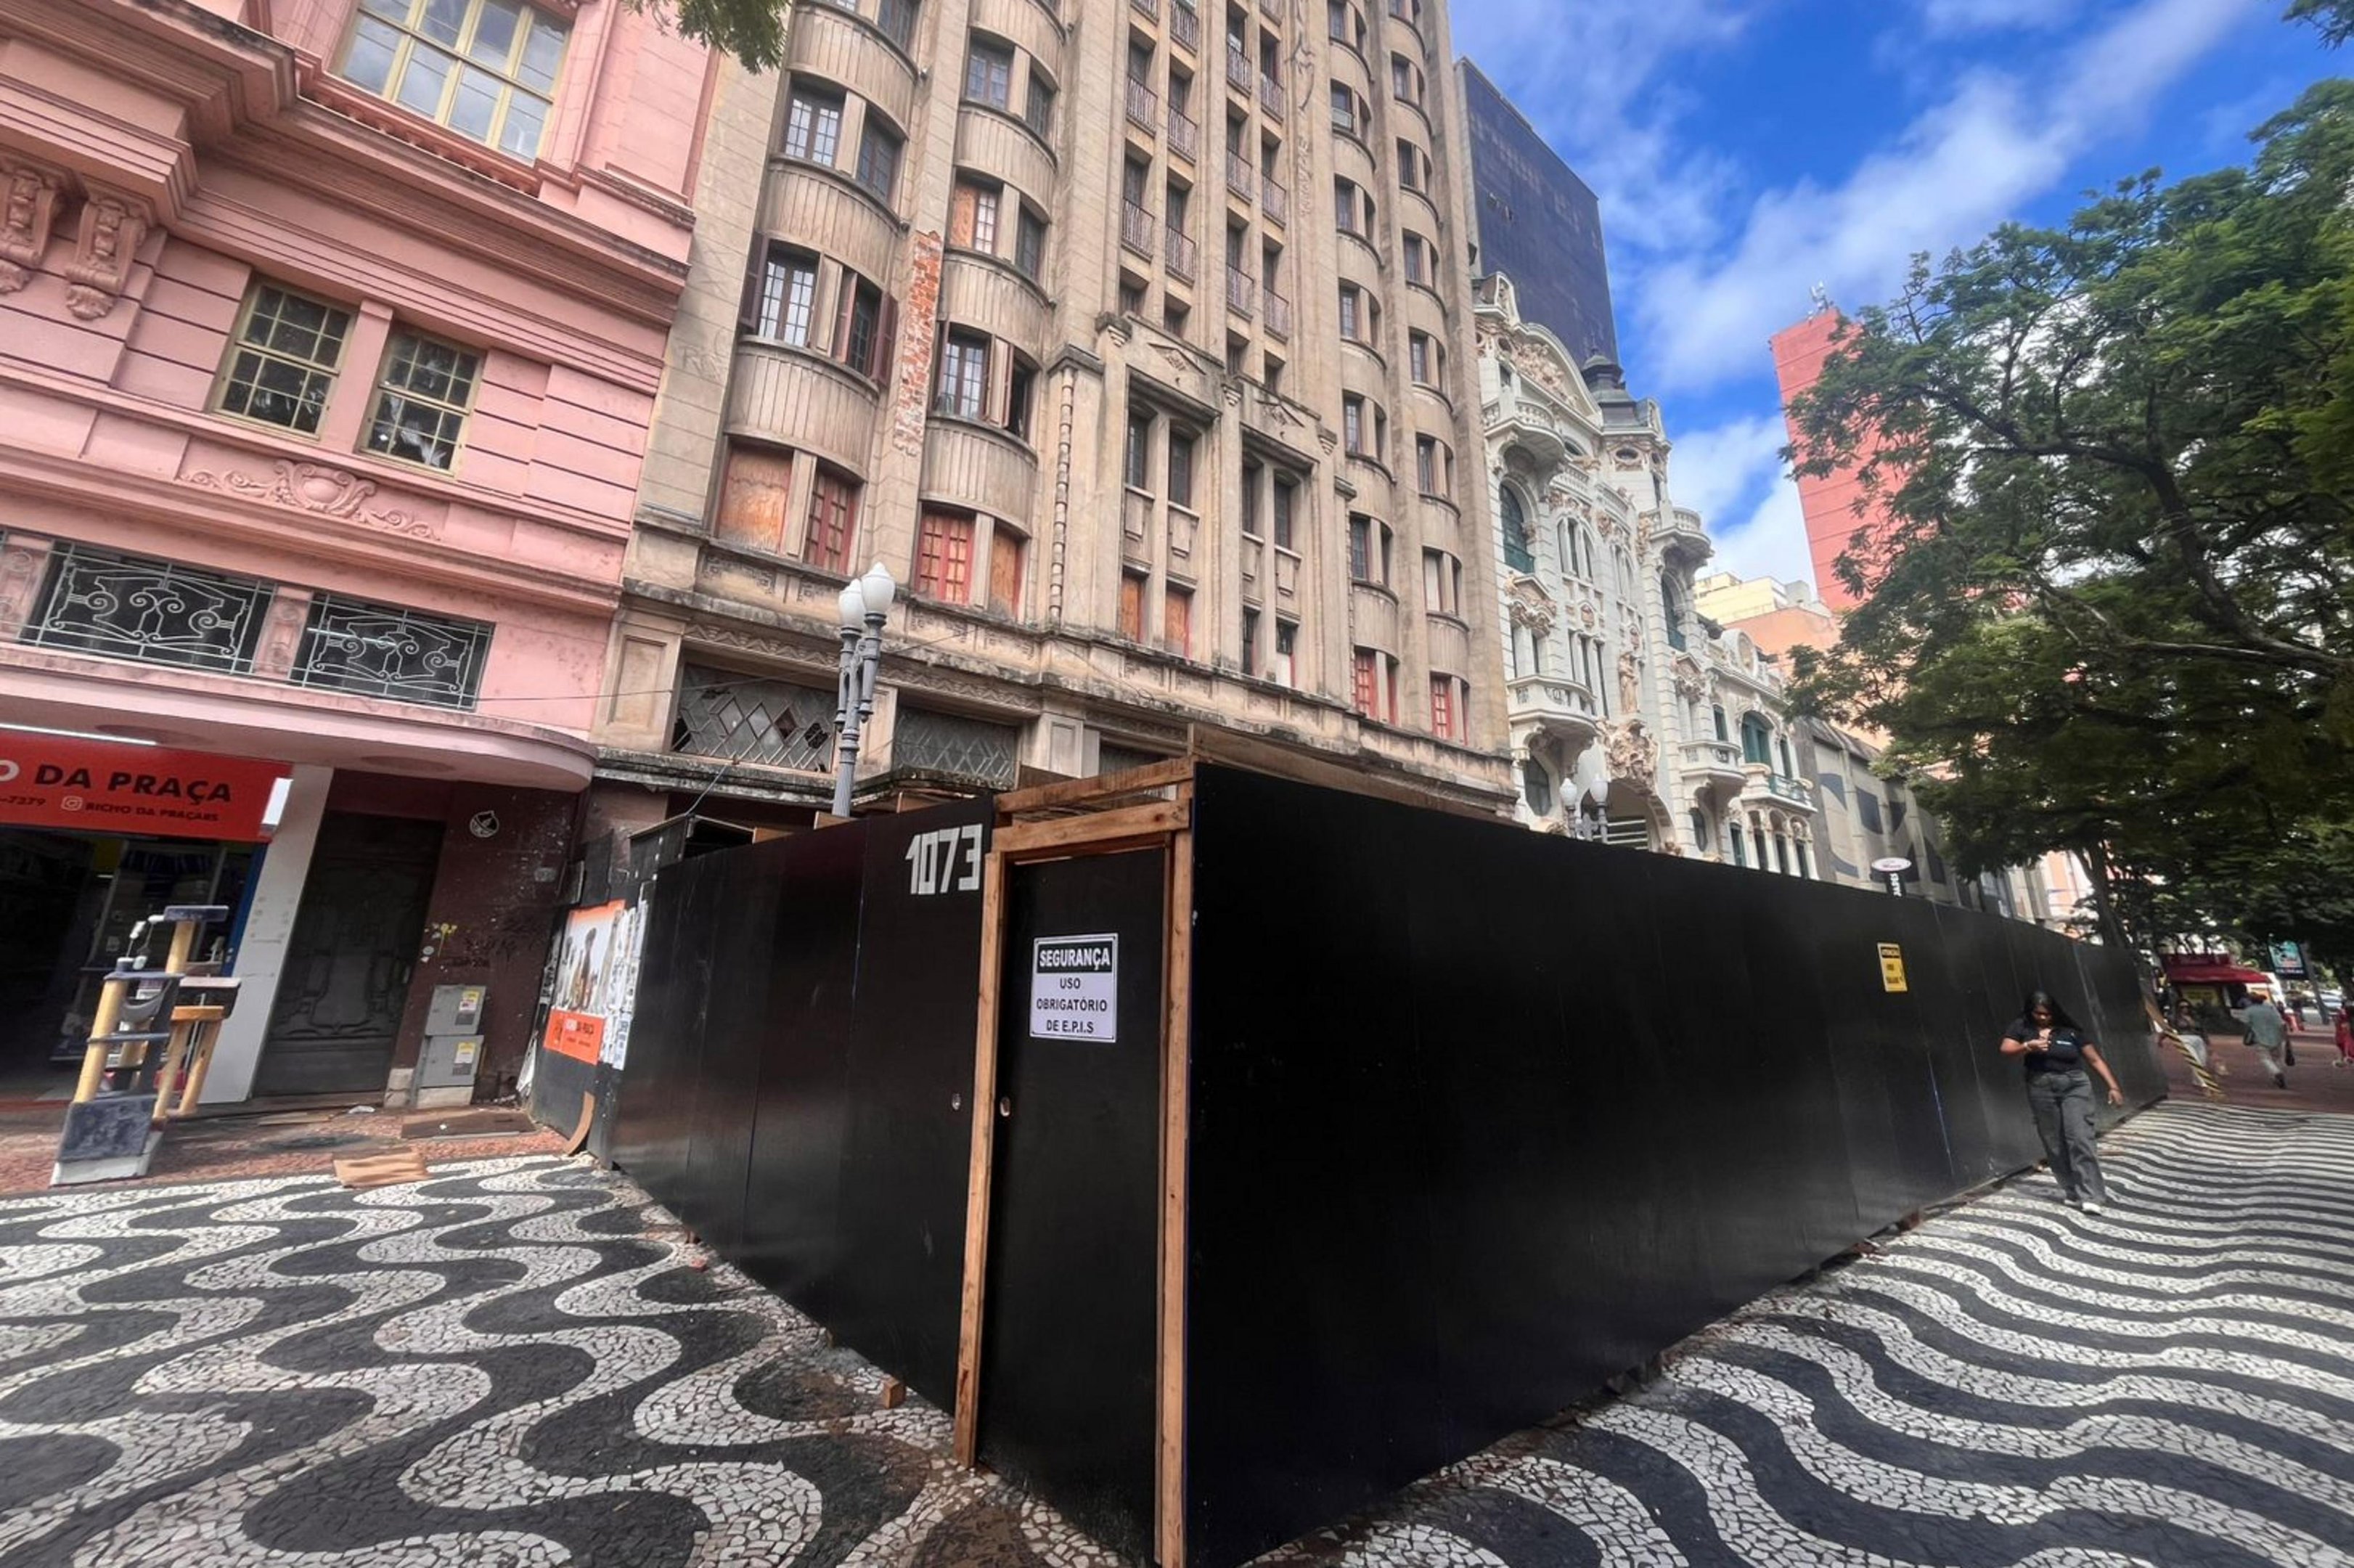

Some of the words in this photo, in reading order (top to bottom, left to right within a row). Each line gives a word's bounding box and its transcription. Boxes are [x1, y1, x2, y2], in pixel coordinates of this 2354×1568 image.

[34, 764, 91, 789] DA
[107, 771, 232, 805] PRAÇA
[905, 823, 983, 895] 1073
[1039, 947, 1111, 971] SEGURANÇA
[1060, 977, 1081, 989] USO
[1037, 997, 1108, 1012] OBRIGATÓRIO
[1046, 1019, 1059, 1032] DE
[1062, 1019, 1094, 1034] E.P.I.S
